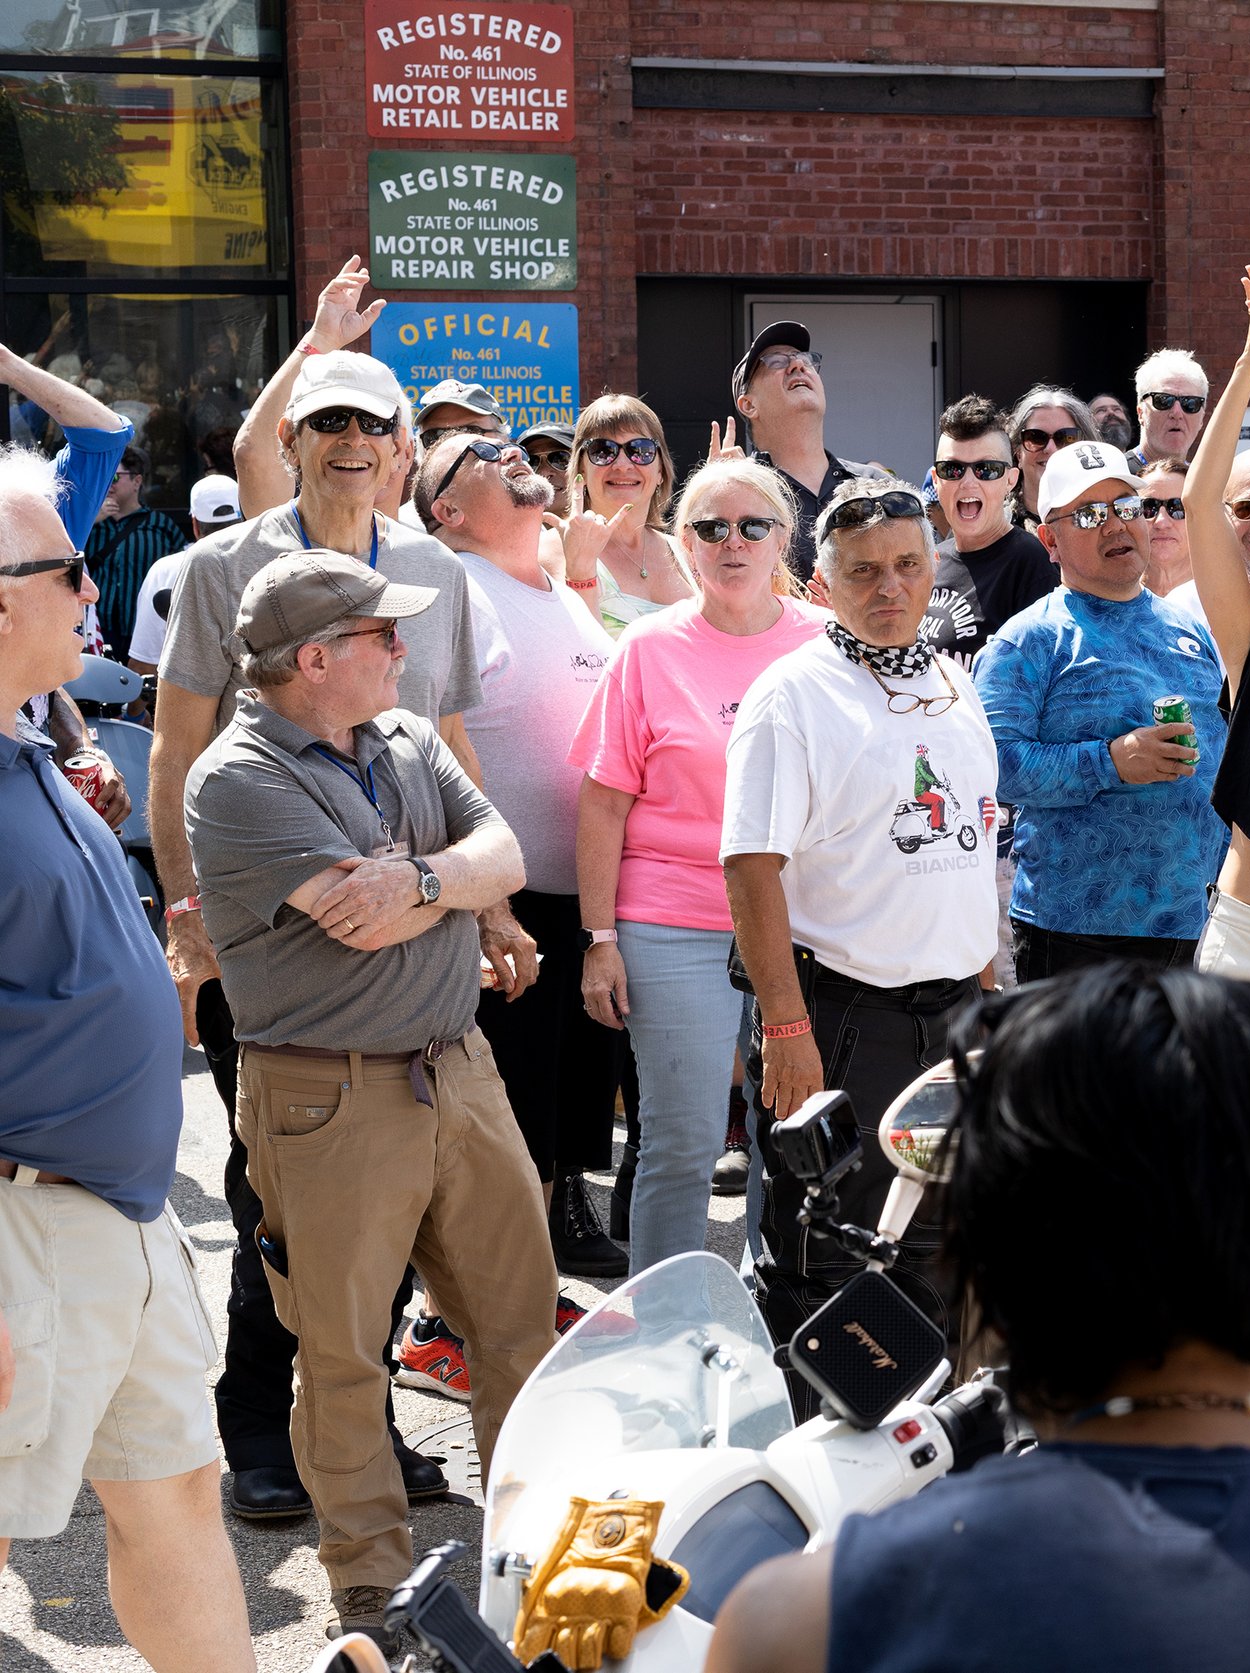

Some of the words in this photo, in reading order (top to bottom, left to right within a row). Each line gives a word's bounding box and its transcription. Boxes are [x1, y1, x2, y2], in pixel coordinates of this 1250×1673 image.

[376, 13, 562, 54] REGISTERED
[439, 45, 468, 60] No.
[471, 46, 501, 61] 461
[404, 64, 449, 79] STATE
[452, 65, 473, 79] OF
[476, 66, 537, 81] ILLINOIS
[372, 84, 461, 105] MOTOR
[470, 86, 568, 108] VEHICLE
[382, 108, 463, 128] RETAIL
[470, 110, 560, 131] DEALER
[379, 164, 564, 205] REGISTERED
[448, 198, 471, 211] No.
[473, 199, 497, 211] 461
[406, 215, 451, 230] STATE
[454, 216, 475, 230] OF
[478, 217, 539, 231] ILLINOIS
[375, 235, 465, 255] MOTOR
[473, 237, 570, 257] VEHICLE
[391, 259, 475, 279] REPAIR
[489, 261, 556, 280] SHOP
[398, 313, 551, 349] OFFICIAL
[451, 348, 475, 360] No.
[476, 348, 501, 361] 461
[410, 366, 454, 380] STATE
[458, 366, 478, 380] OF
[482, 366, 542, 380] ILLINOIS
[948, 595, 978, 641] YOUR
[904, 853, 981, 877] BIANCO
[842, 1321, 898, 1370] Marshall
